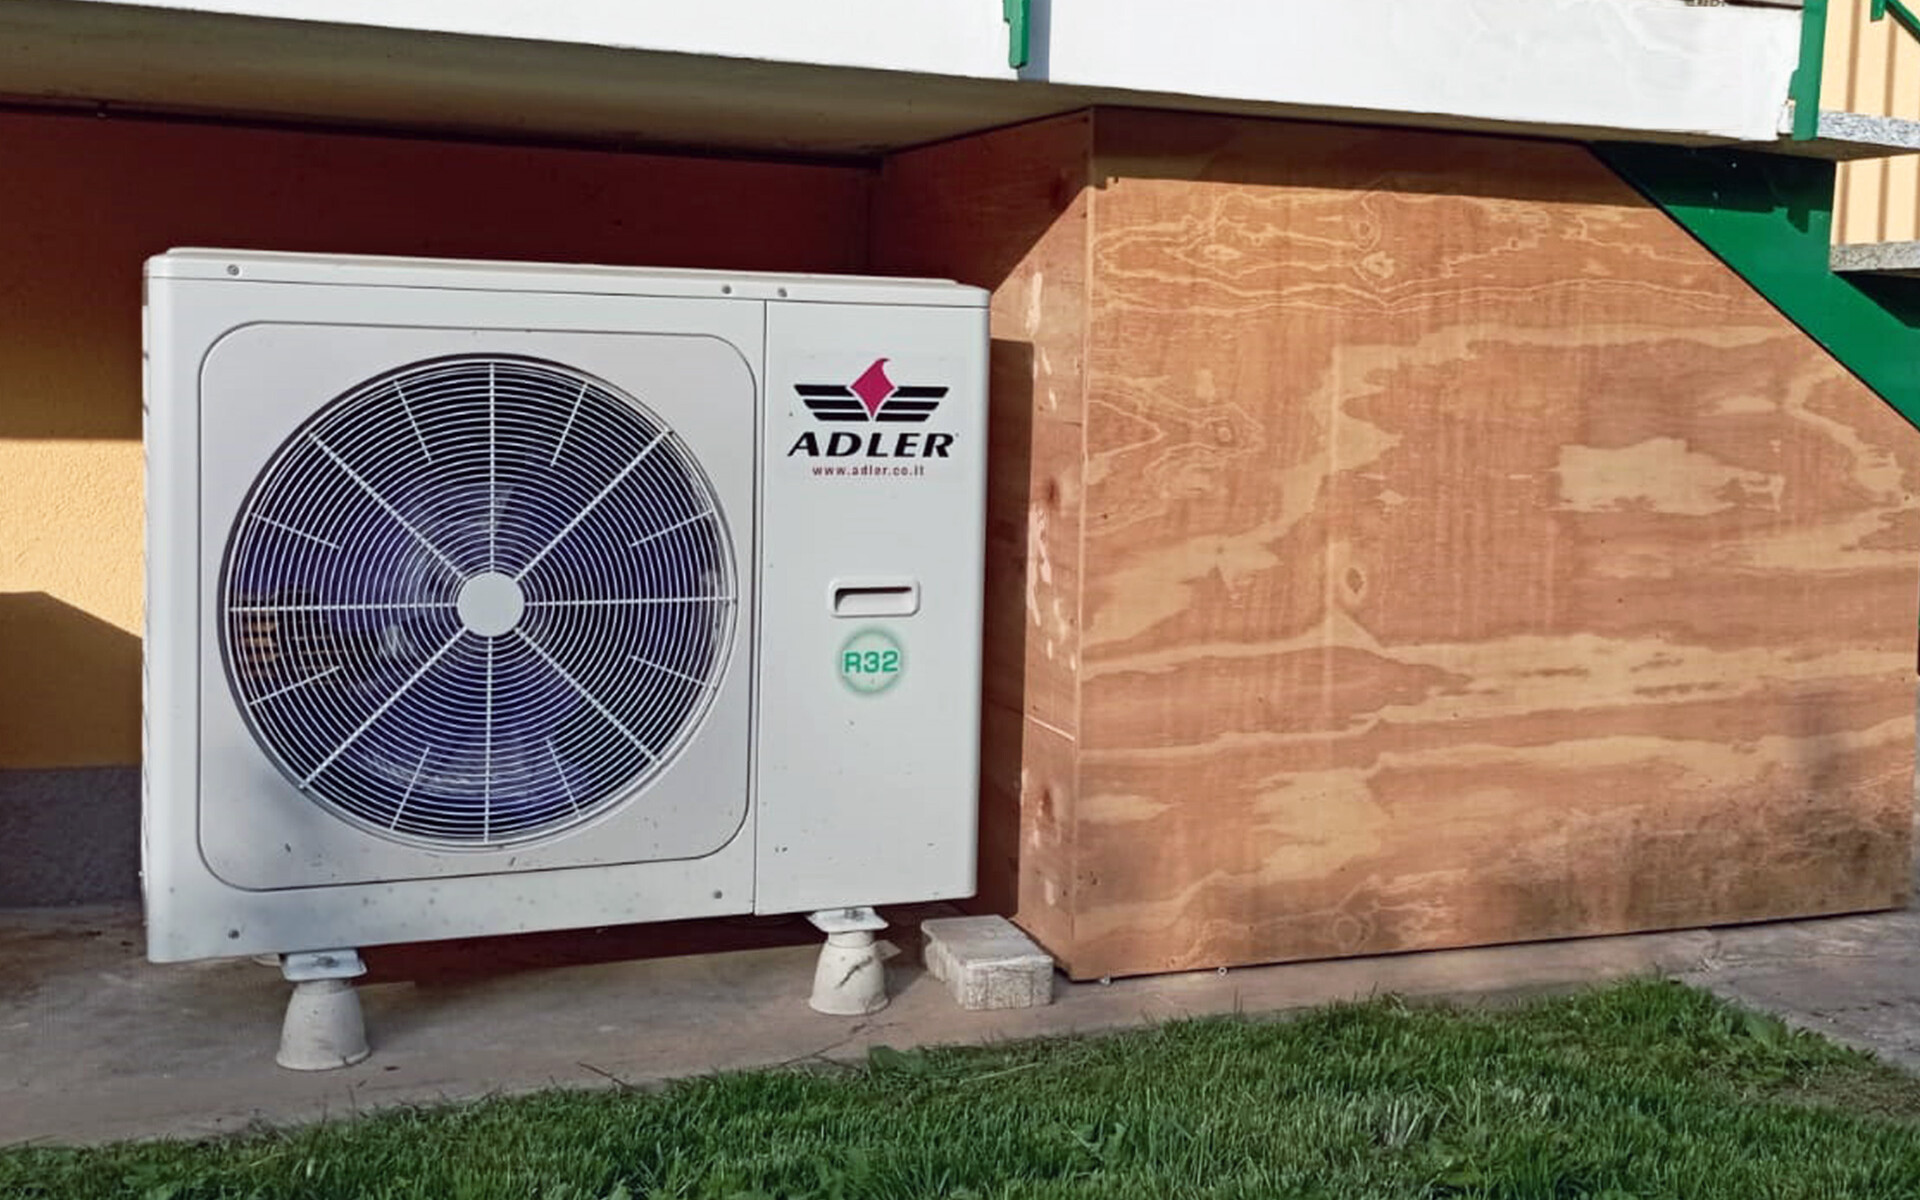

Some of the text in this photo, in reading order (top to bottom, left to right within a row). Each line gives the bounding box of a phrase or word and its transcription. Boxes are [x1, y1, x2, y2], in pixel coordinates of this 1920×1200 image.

[787, 431, 954, 458] ADLER
[812, 464, 925, 476] www.adler.co.it
[844, 651, 898, 673] R32
